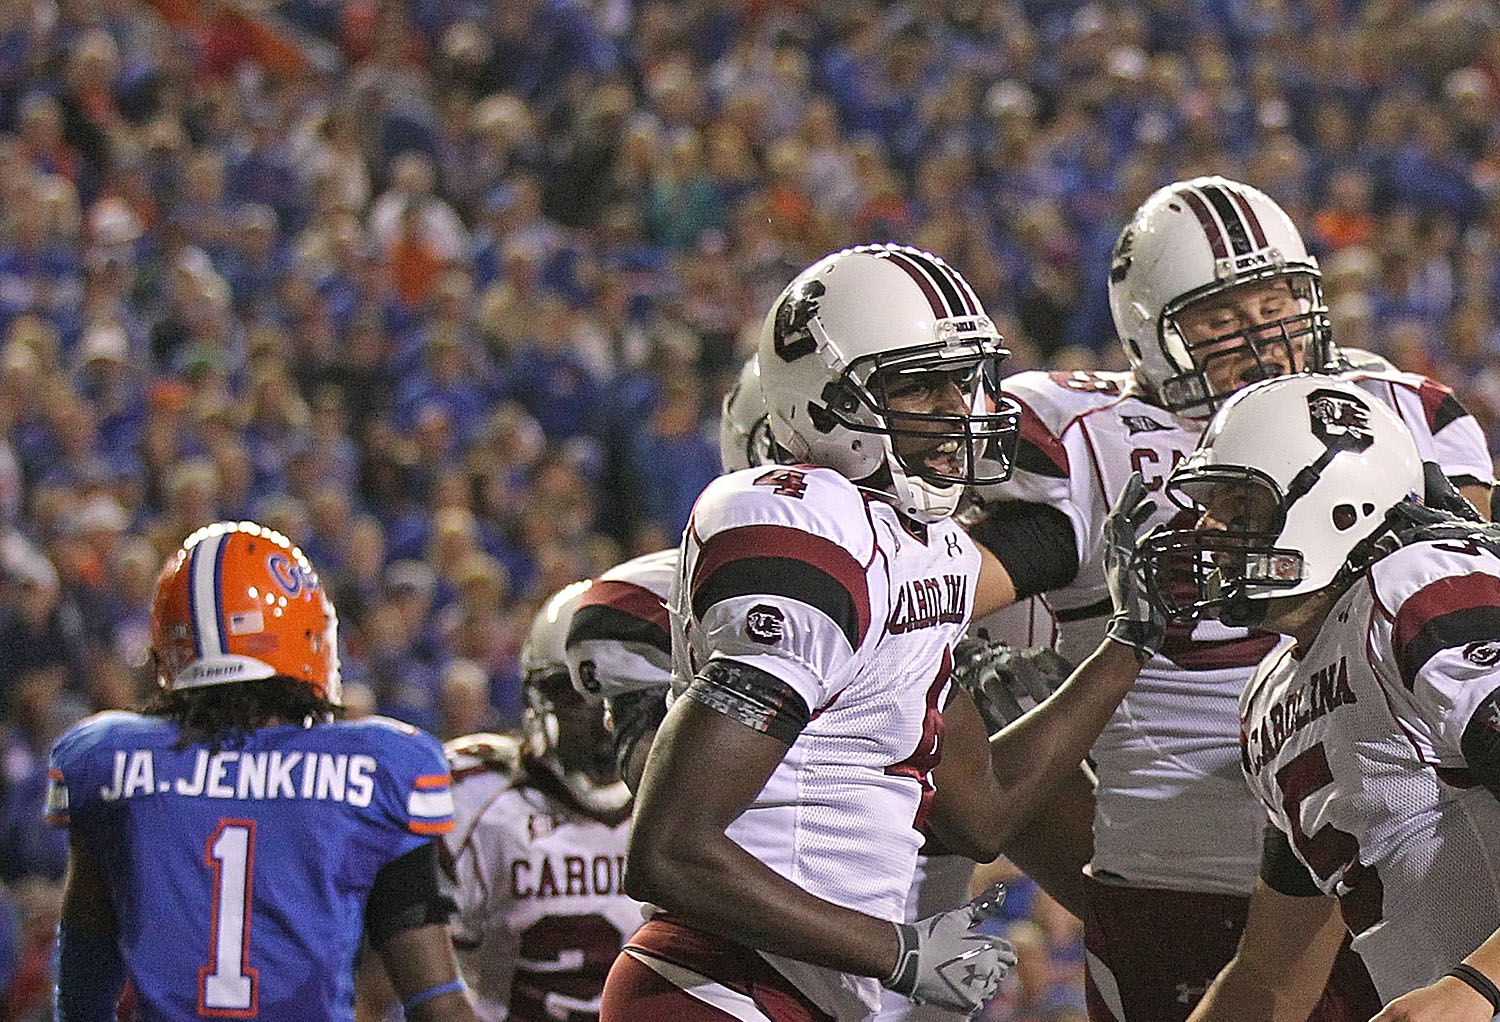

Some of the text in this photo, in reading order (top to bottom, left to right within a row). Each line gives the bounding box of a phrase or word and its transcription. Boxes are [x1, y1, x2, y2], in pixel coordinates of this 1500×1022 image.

[752, 468, 809, 500] 4
[100, 747, 378, 809] JA.JENKINS
[197, 817, 260, 1018] 1
